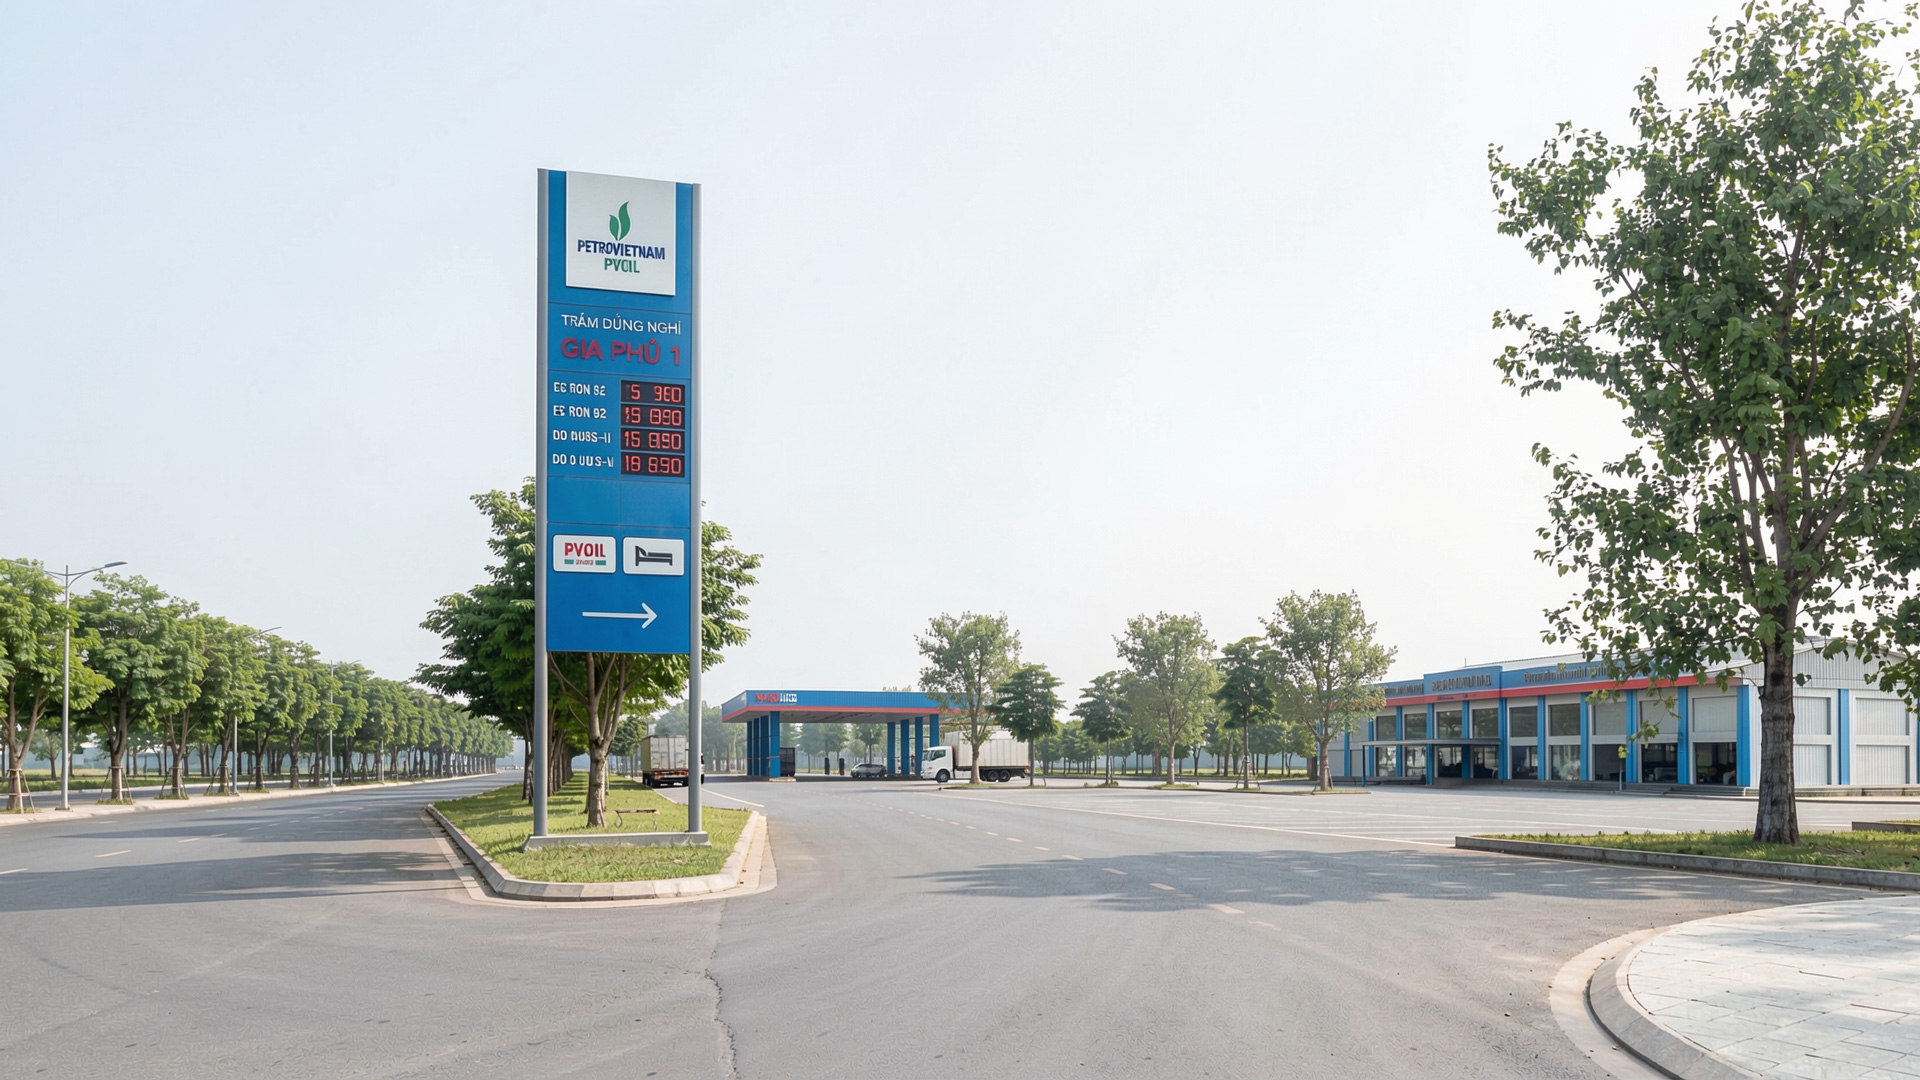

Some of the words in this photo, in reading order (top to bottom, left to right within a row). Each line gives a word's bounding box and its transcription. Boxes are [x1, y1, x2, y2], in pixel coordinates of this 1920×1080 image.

[577, 239, 666, 260] PETROVIETNAM
[561, 337, 604, 361] GIA
[670, 346, 681, 366] 1
[568, 406, 591, 418] RON
[552, 429, 568, 441] DO
[552, 453, 568, 465] DO
[564, 542, 607, 558] PVOIL
